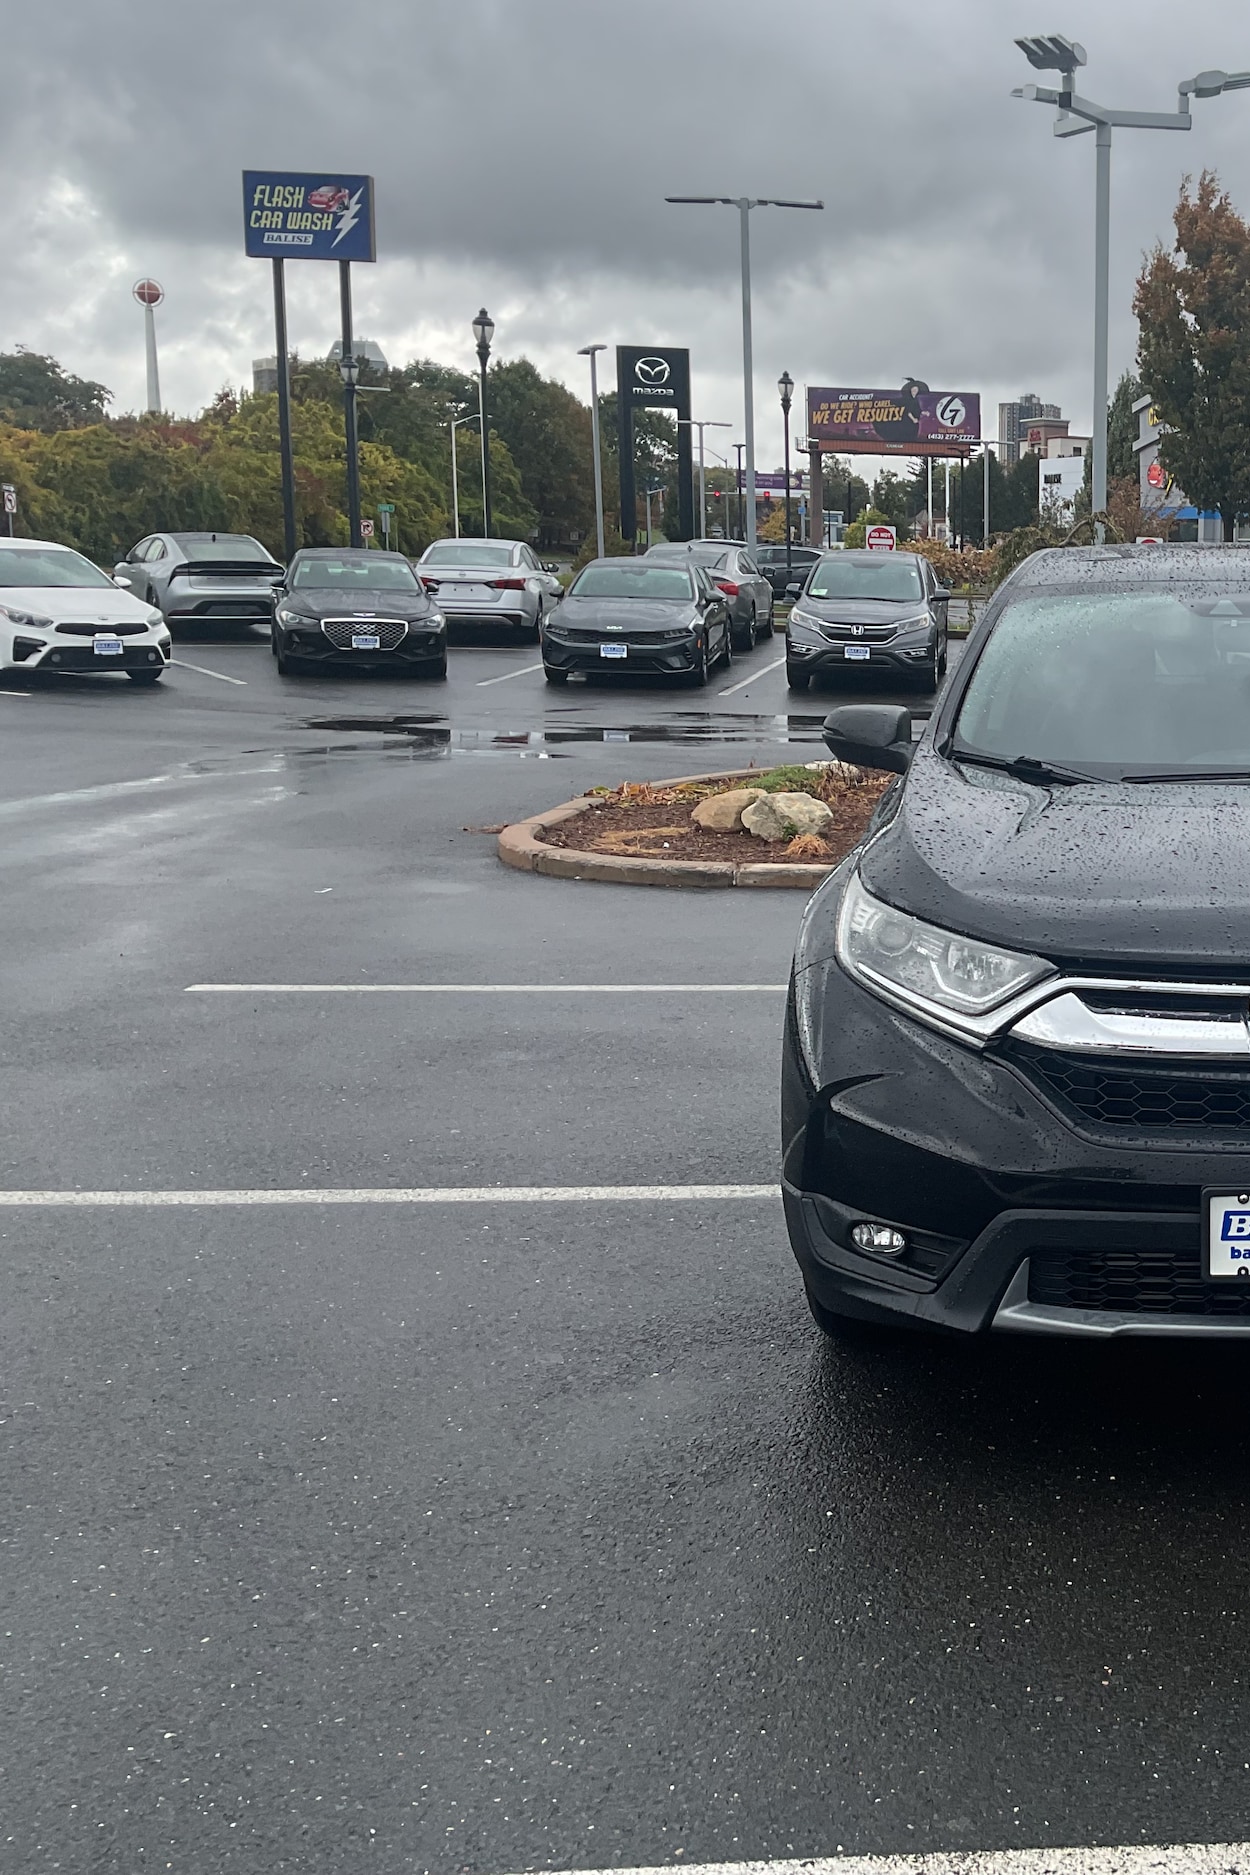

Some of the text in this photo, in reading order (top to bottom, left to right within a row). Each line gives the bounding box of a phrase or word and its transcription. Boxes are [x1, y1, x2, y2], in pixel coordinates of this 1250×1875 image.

[254, 185, 304, 208] FLASH
[250, 211, 333, 230] CAR WASH
[265, 234, 311, 244] BALISE
[820, 402, 829, 410] DO
[812, 407, 905, 424] WE GET RESULTS!
